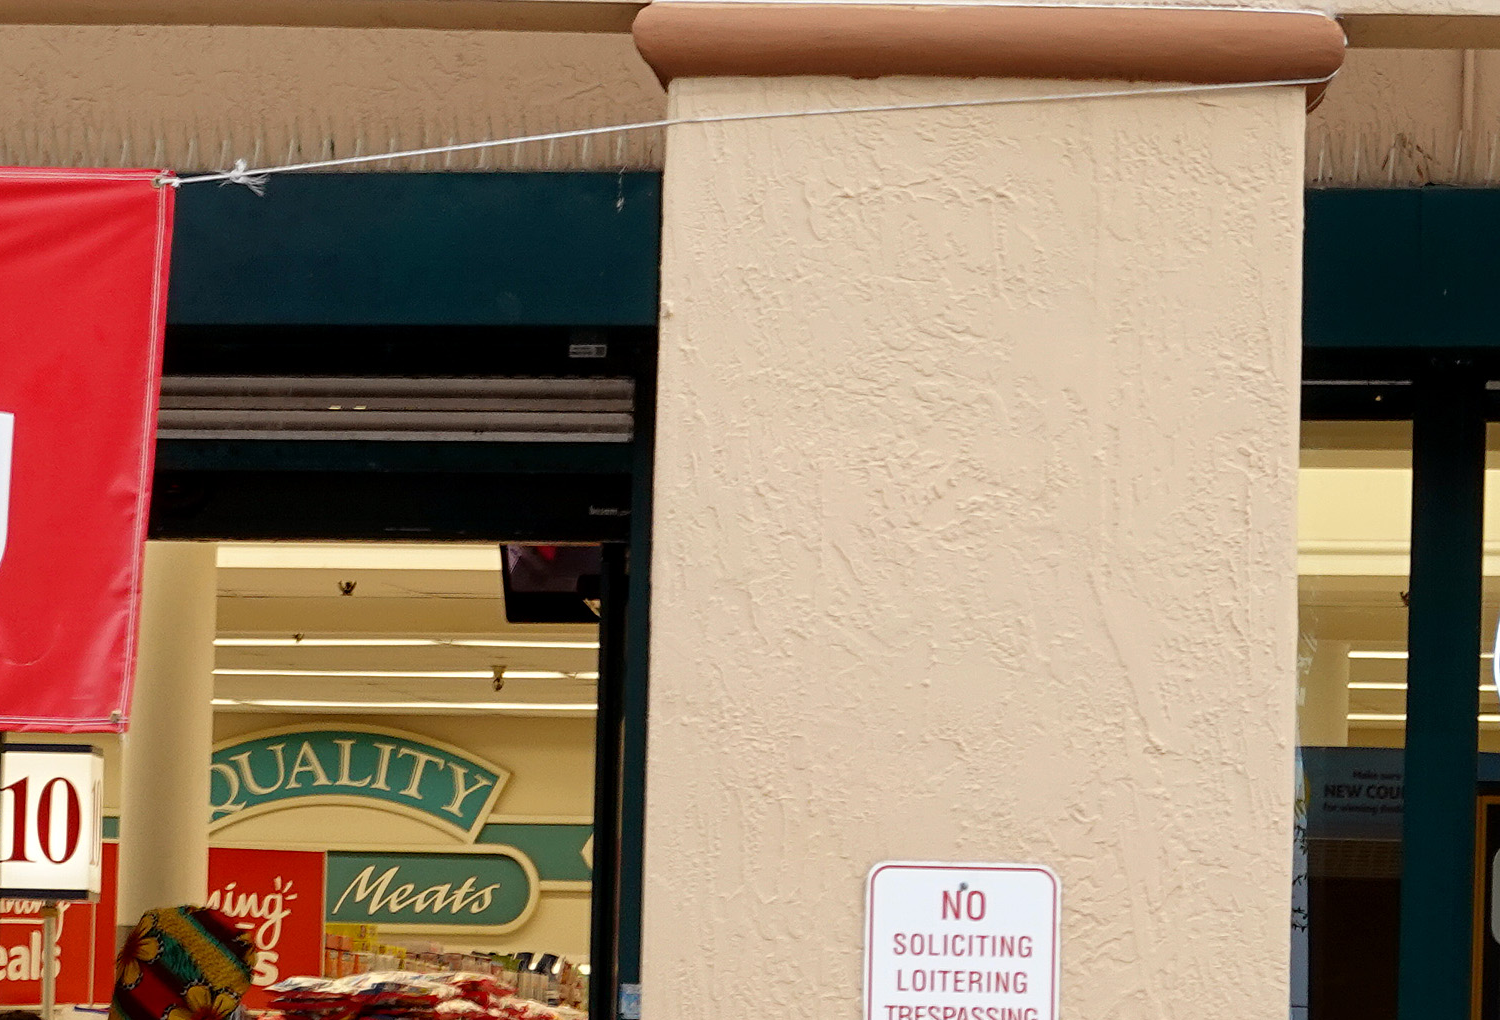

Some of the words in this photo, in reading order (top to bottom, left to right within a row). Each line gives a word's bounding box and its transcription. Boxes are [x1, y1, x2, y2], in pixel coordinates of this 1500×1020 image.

[209, 739, 496, 819] QUALITY
[332, 864, 501, 916] Meats
[941, 889, 987, 922] NO
[893, 932, 1033, 959] SOLICITING
[896, 968, 1029, 994] LOITERING
